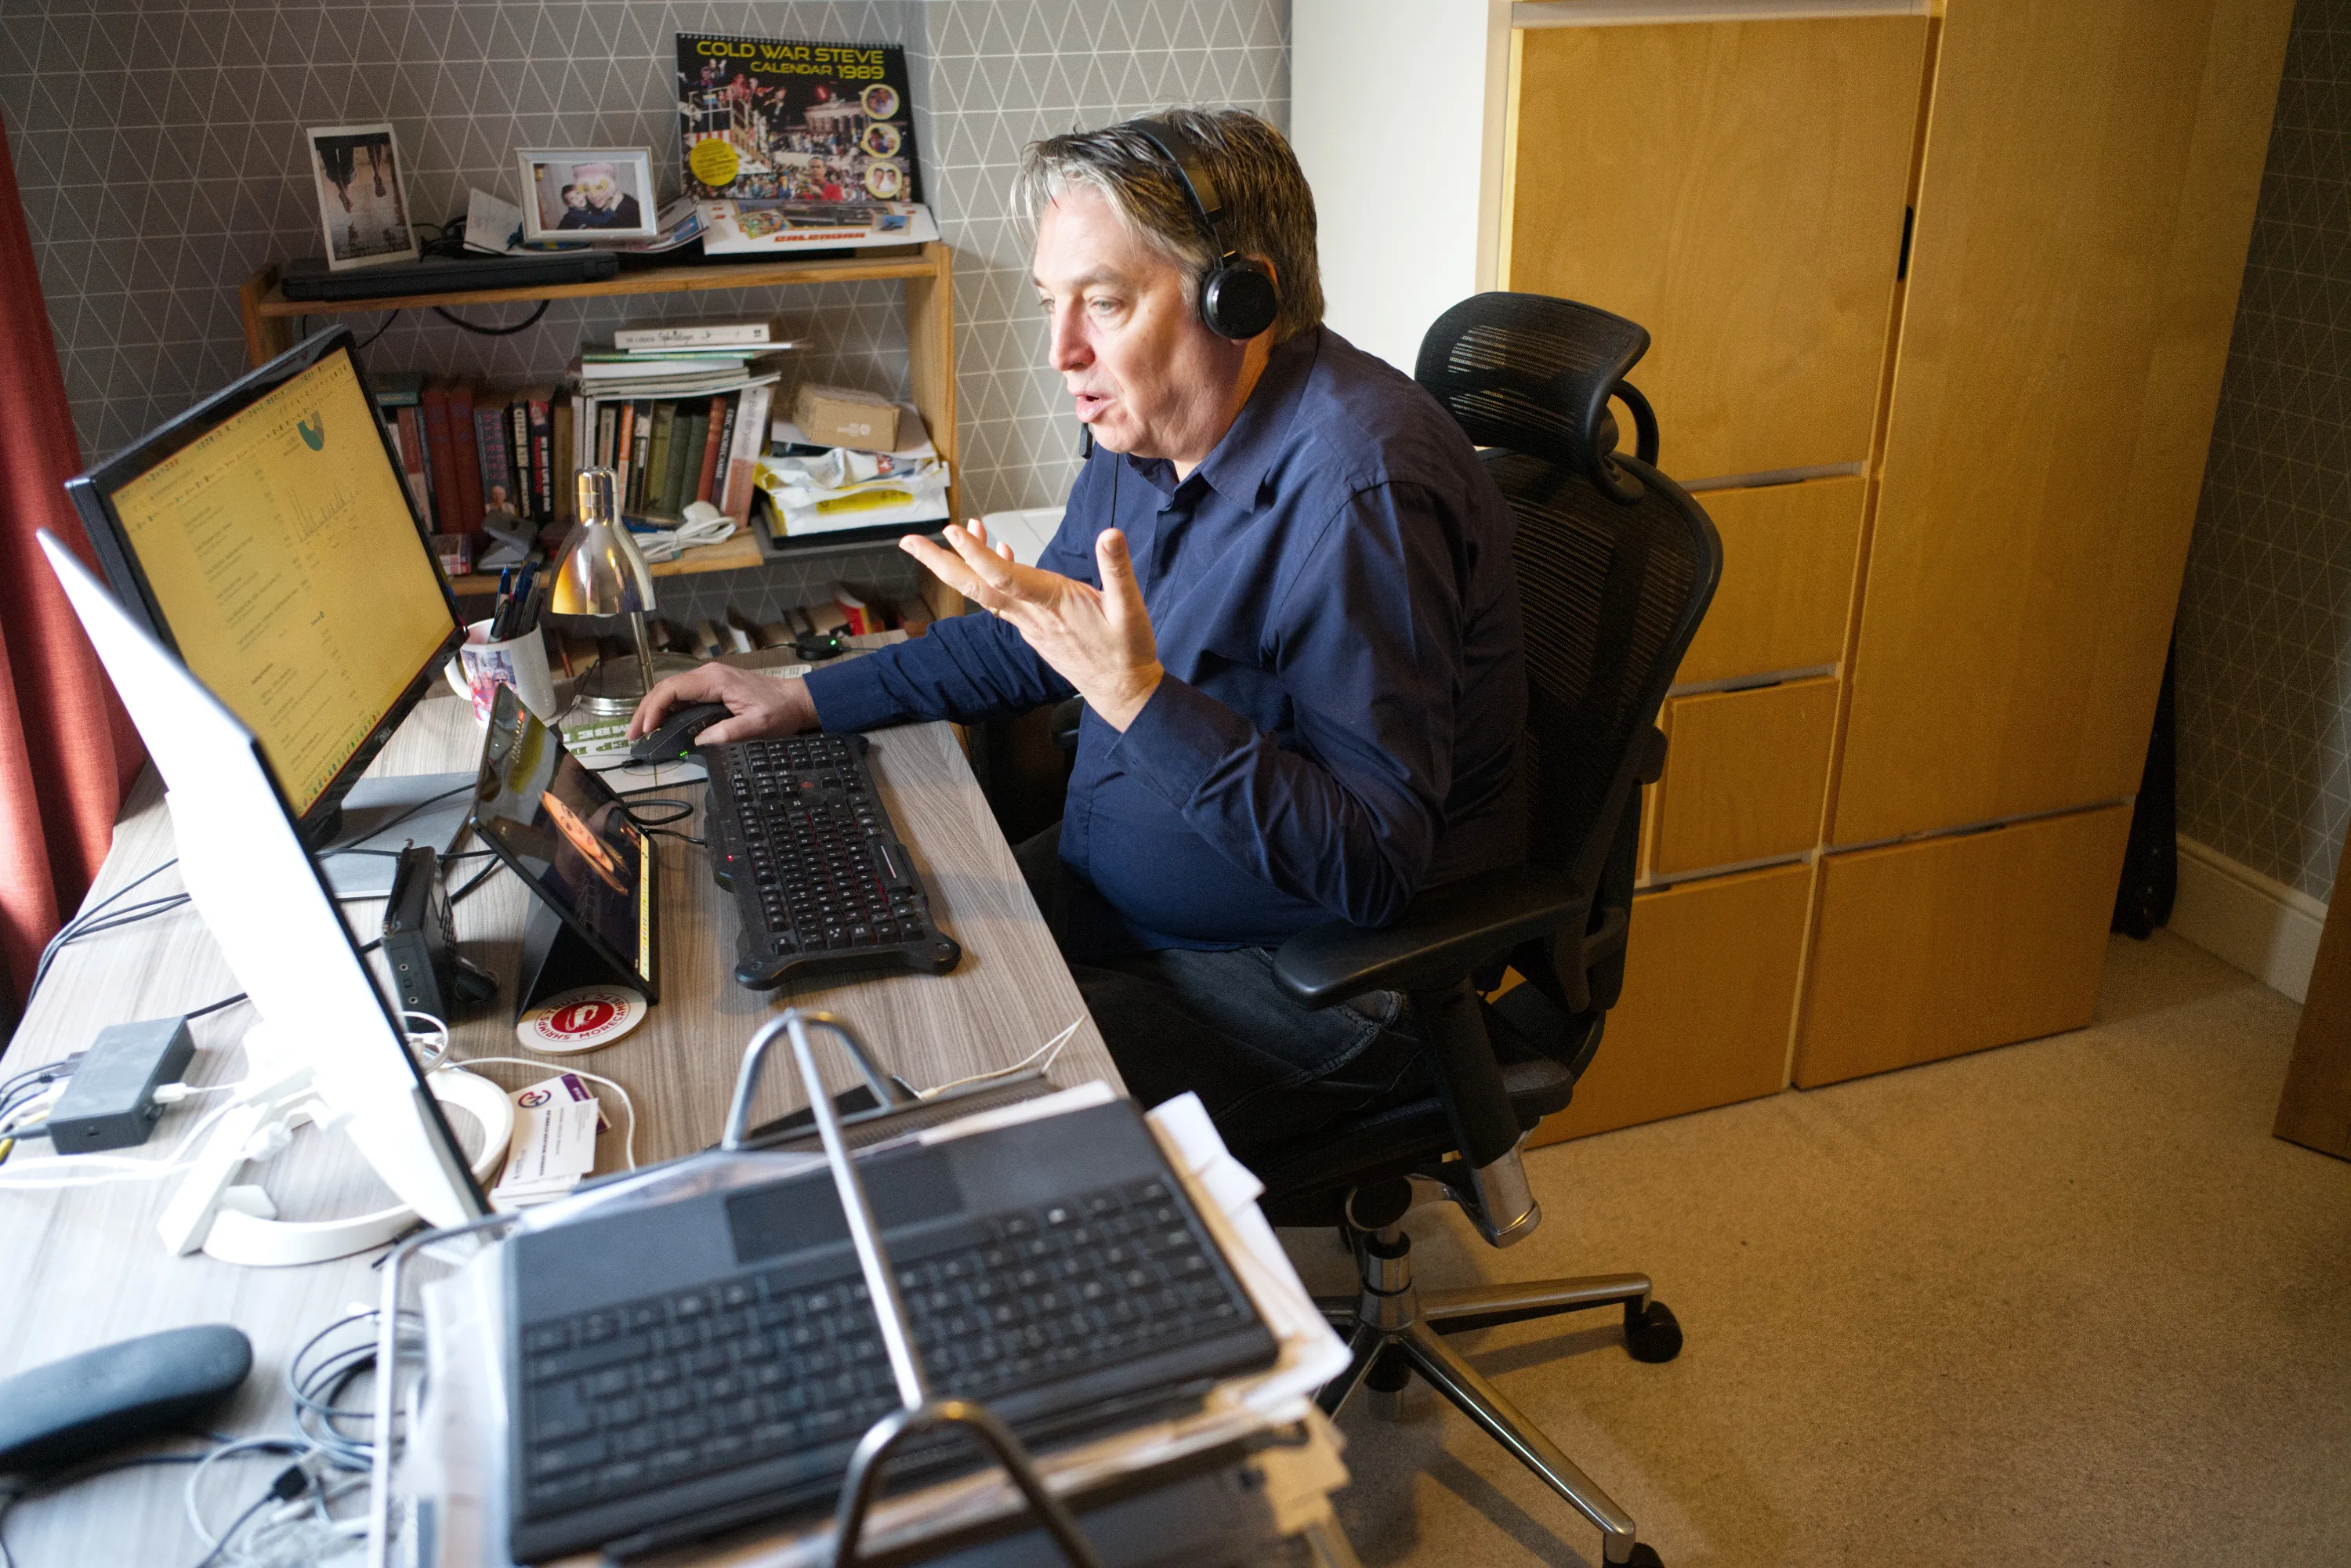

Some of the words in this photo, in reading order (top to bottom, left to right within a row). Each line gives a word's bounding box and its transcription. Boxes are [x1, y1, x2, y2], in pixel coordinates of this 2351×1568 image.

[697, 41, 755, 57] COLD
[759, 44, 810, 60] WAR
[815, 48, 884, 64] STEVE
[751, 61, 832, 75] CALENDAR
[836, 65, 885, 79] 1989
[724, 407, 734, 426] ERIC
[715, 427, 730, 479] MORECAMBE
[547, 995, 587, 1014] TRUST
[538, 1016, 571, 1040] SHRIMPS
[579, 998, 628, 1038] MORECAMBE
